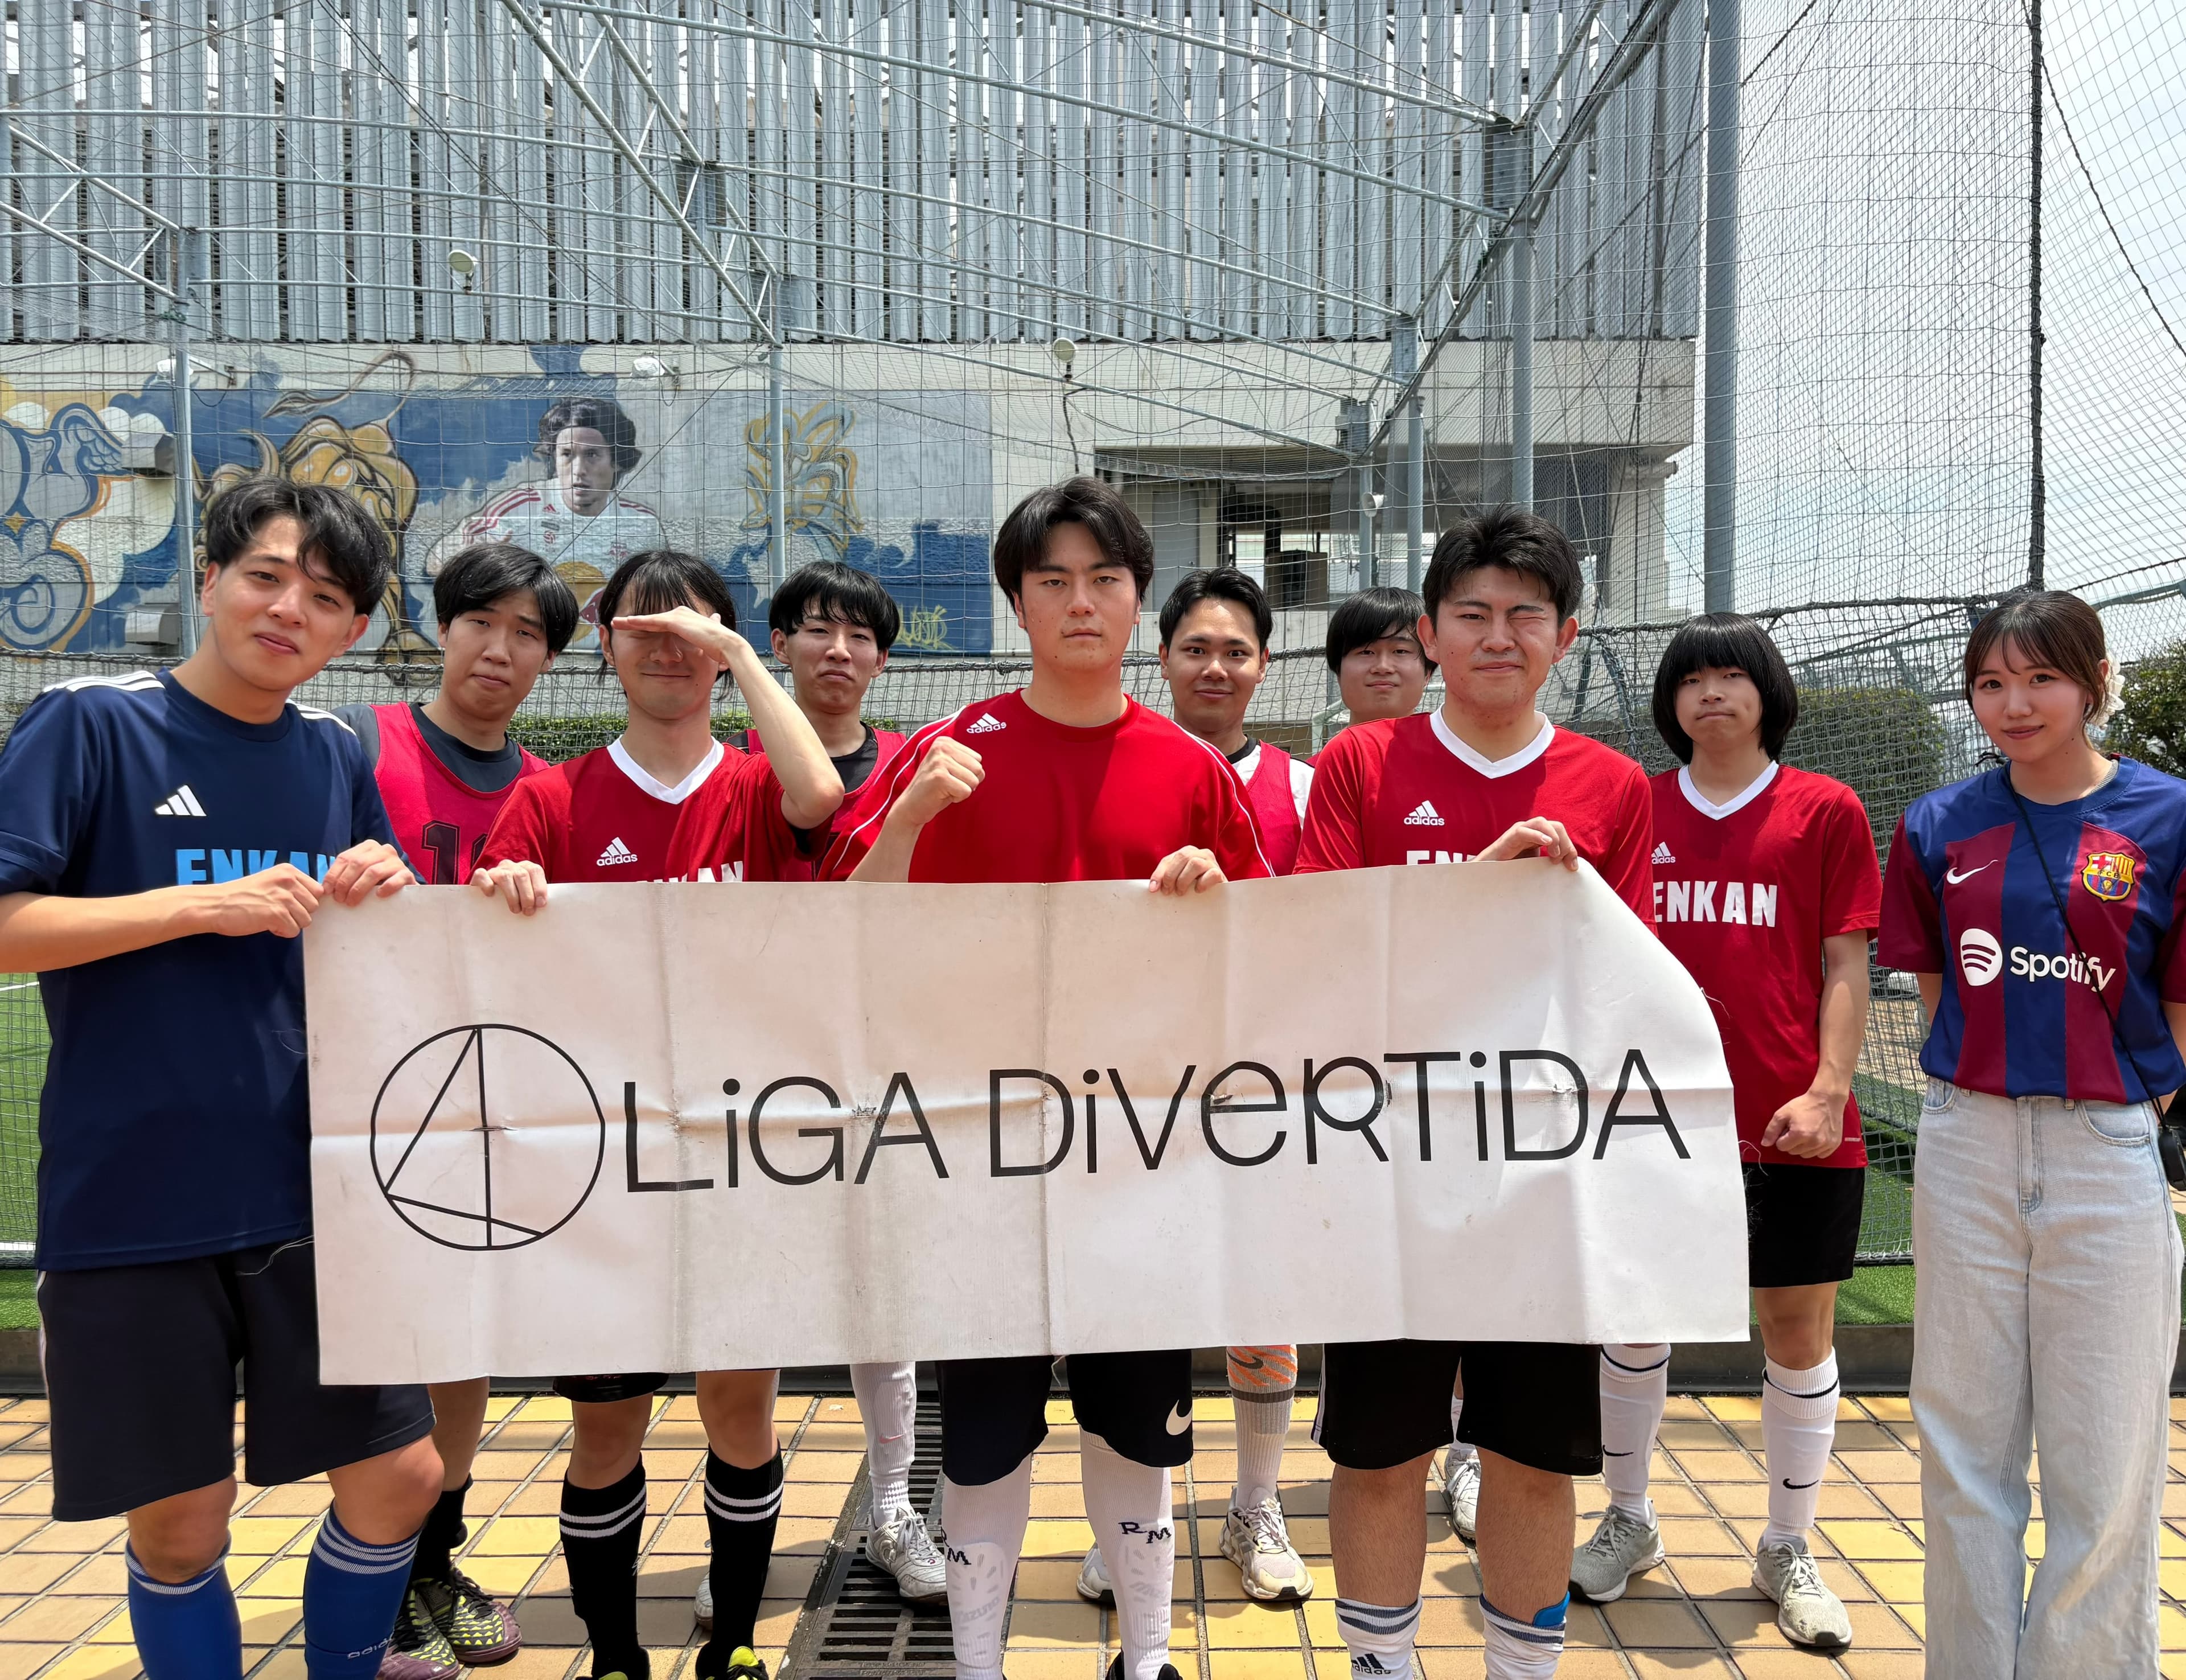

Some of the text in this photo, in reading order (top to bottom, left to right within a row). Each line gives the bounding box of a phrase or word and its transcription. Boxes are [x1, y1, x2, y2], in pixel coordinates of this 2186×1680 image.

[966, 722, 1006, 734] adidas
[1403, 815, 1445, 825] adidas
[596, 853, 638, 866] adidas
[1651, 856, 1676, 864] didas
[2010, 946, 2117, 992] Spotify
[346, 1638, 388, 1659] adid
[1352, 1663, 1391, 1675] didas
